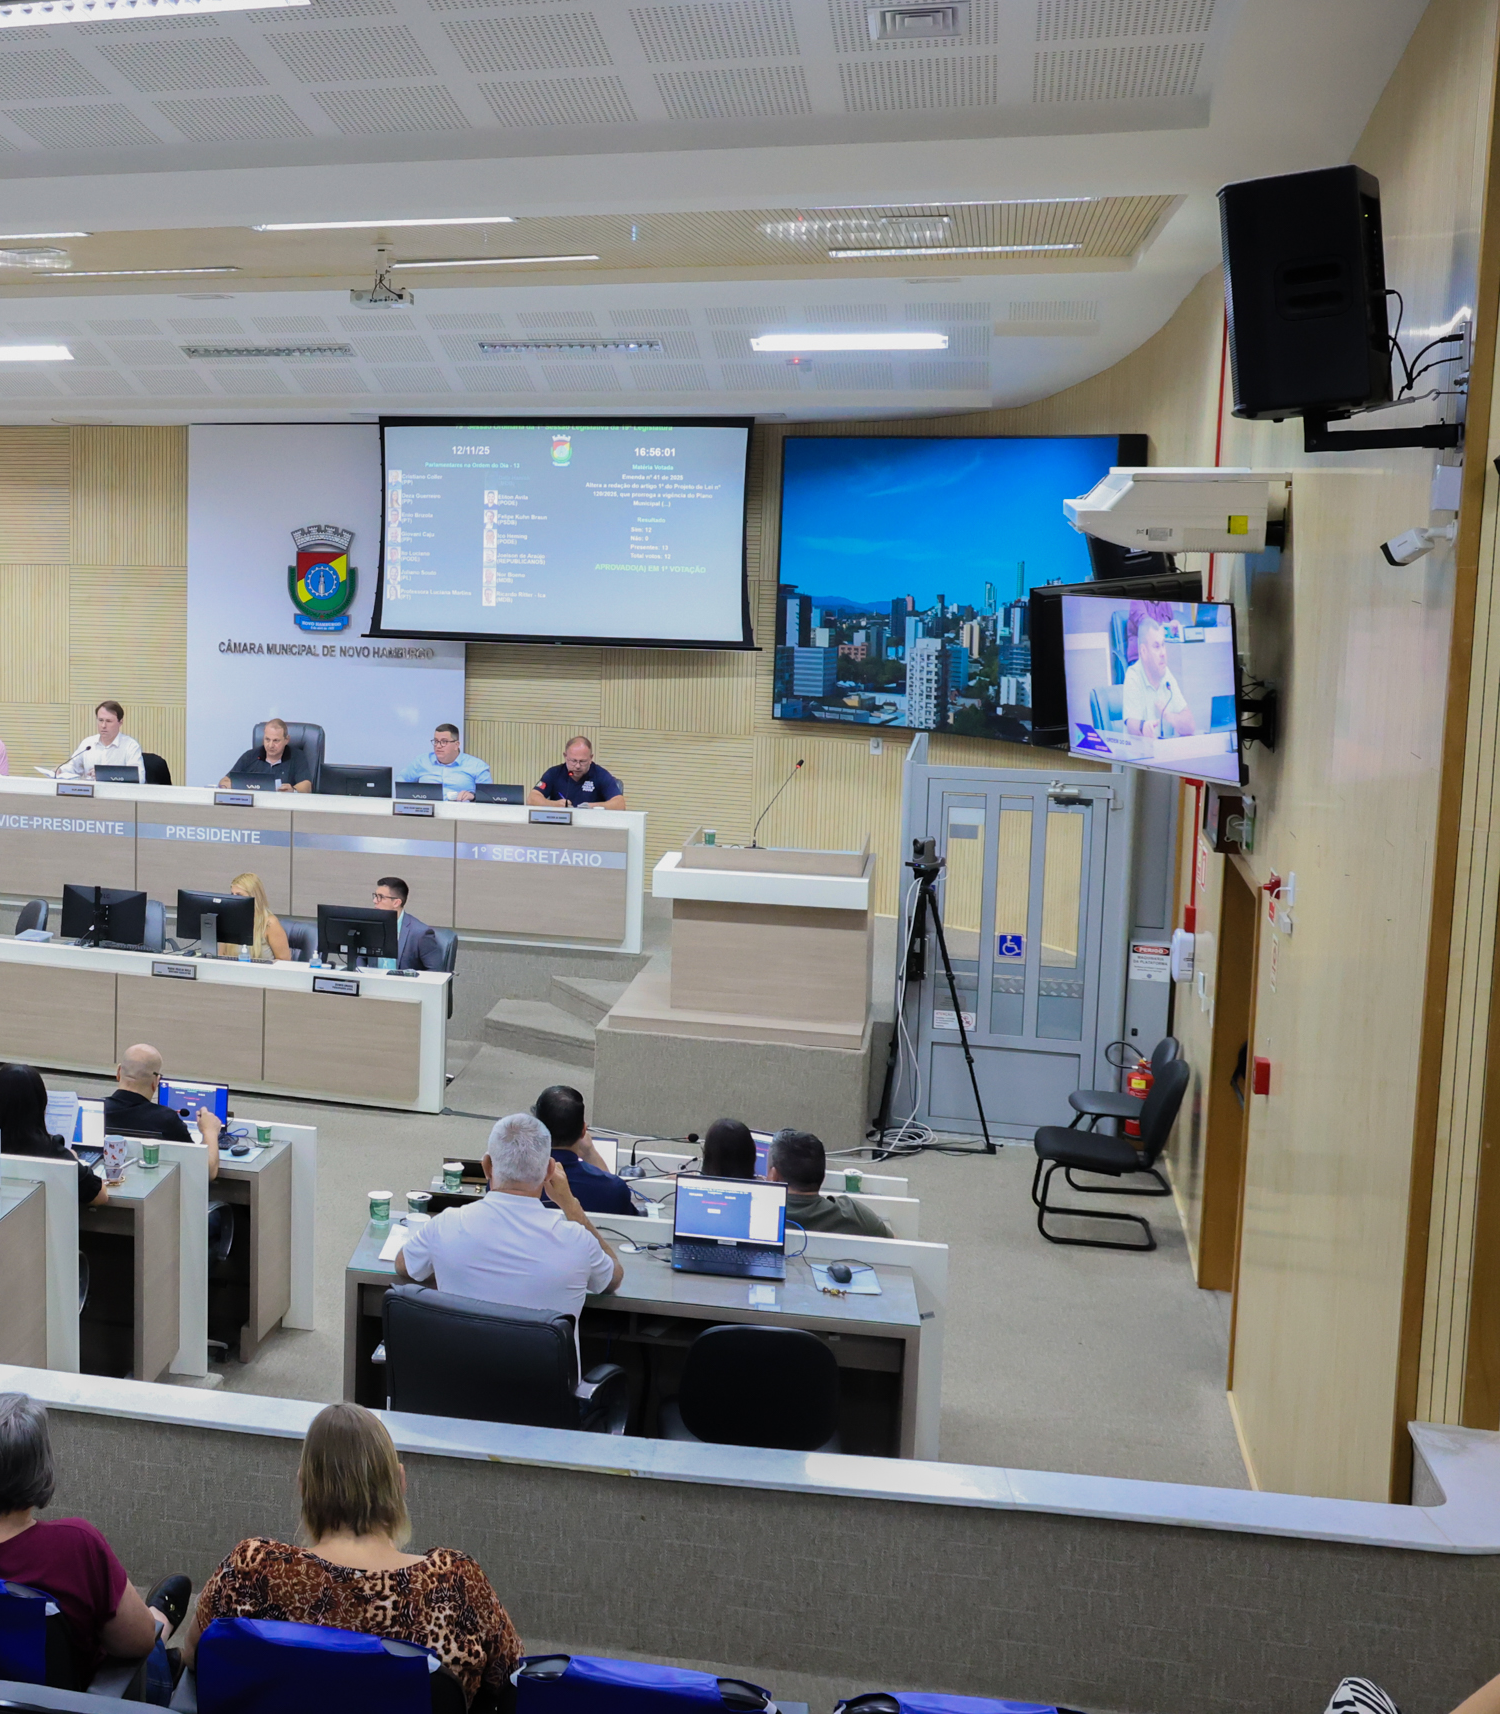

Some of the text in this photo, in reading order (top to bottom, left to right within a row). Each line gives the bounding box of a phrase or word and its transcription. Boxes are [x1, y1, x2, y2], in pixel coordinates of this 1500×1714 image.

[451, 446, 490, 455] 12/11/25
[634, 447, 676, 457] 16:56:01
[594, 563, 646, 572] APROVADO(A)
[670, 564, 706, 574] VOTAÇÃO
[217, 640, 435, 660] CÂMARA MUNICIPAL DE NOVO HAMBURGO
[166, 825, 261, 845] PRESIDENTE
[491, 845, 602, 868] SECRETÁRIO
